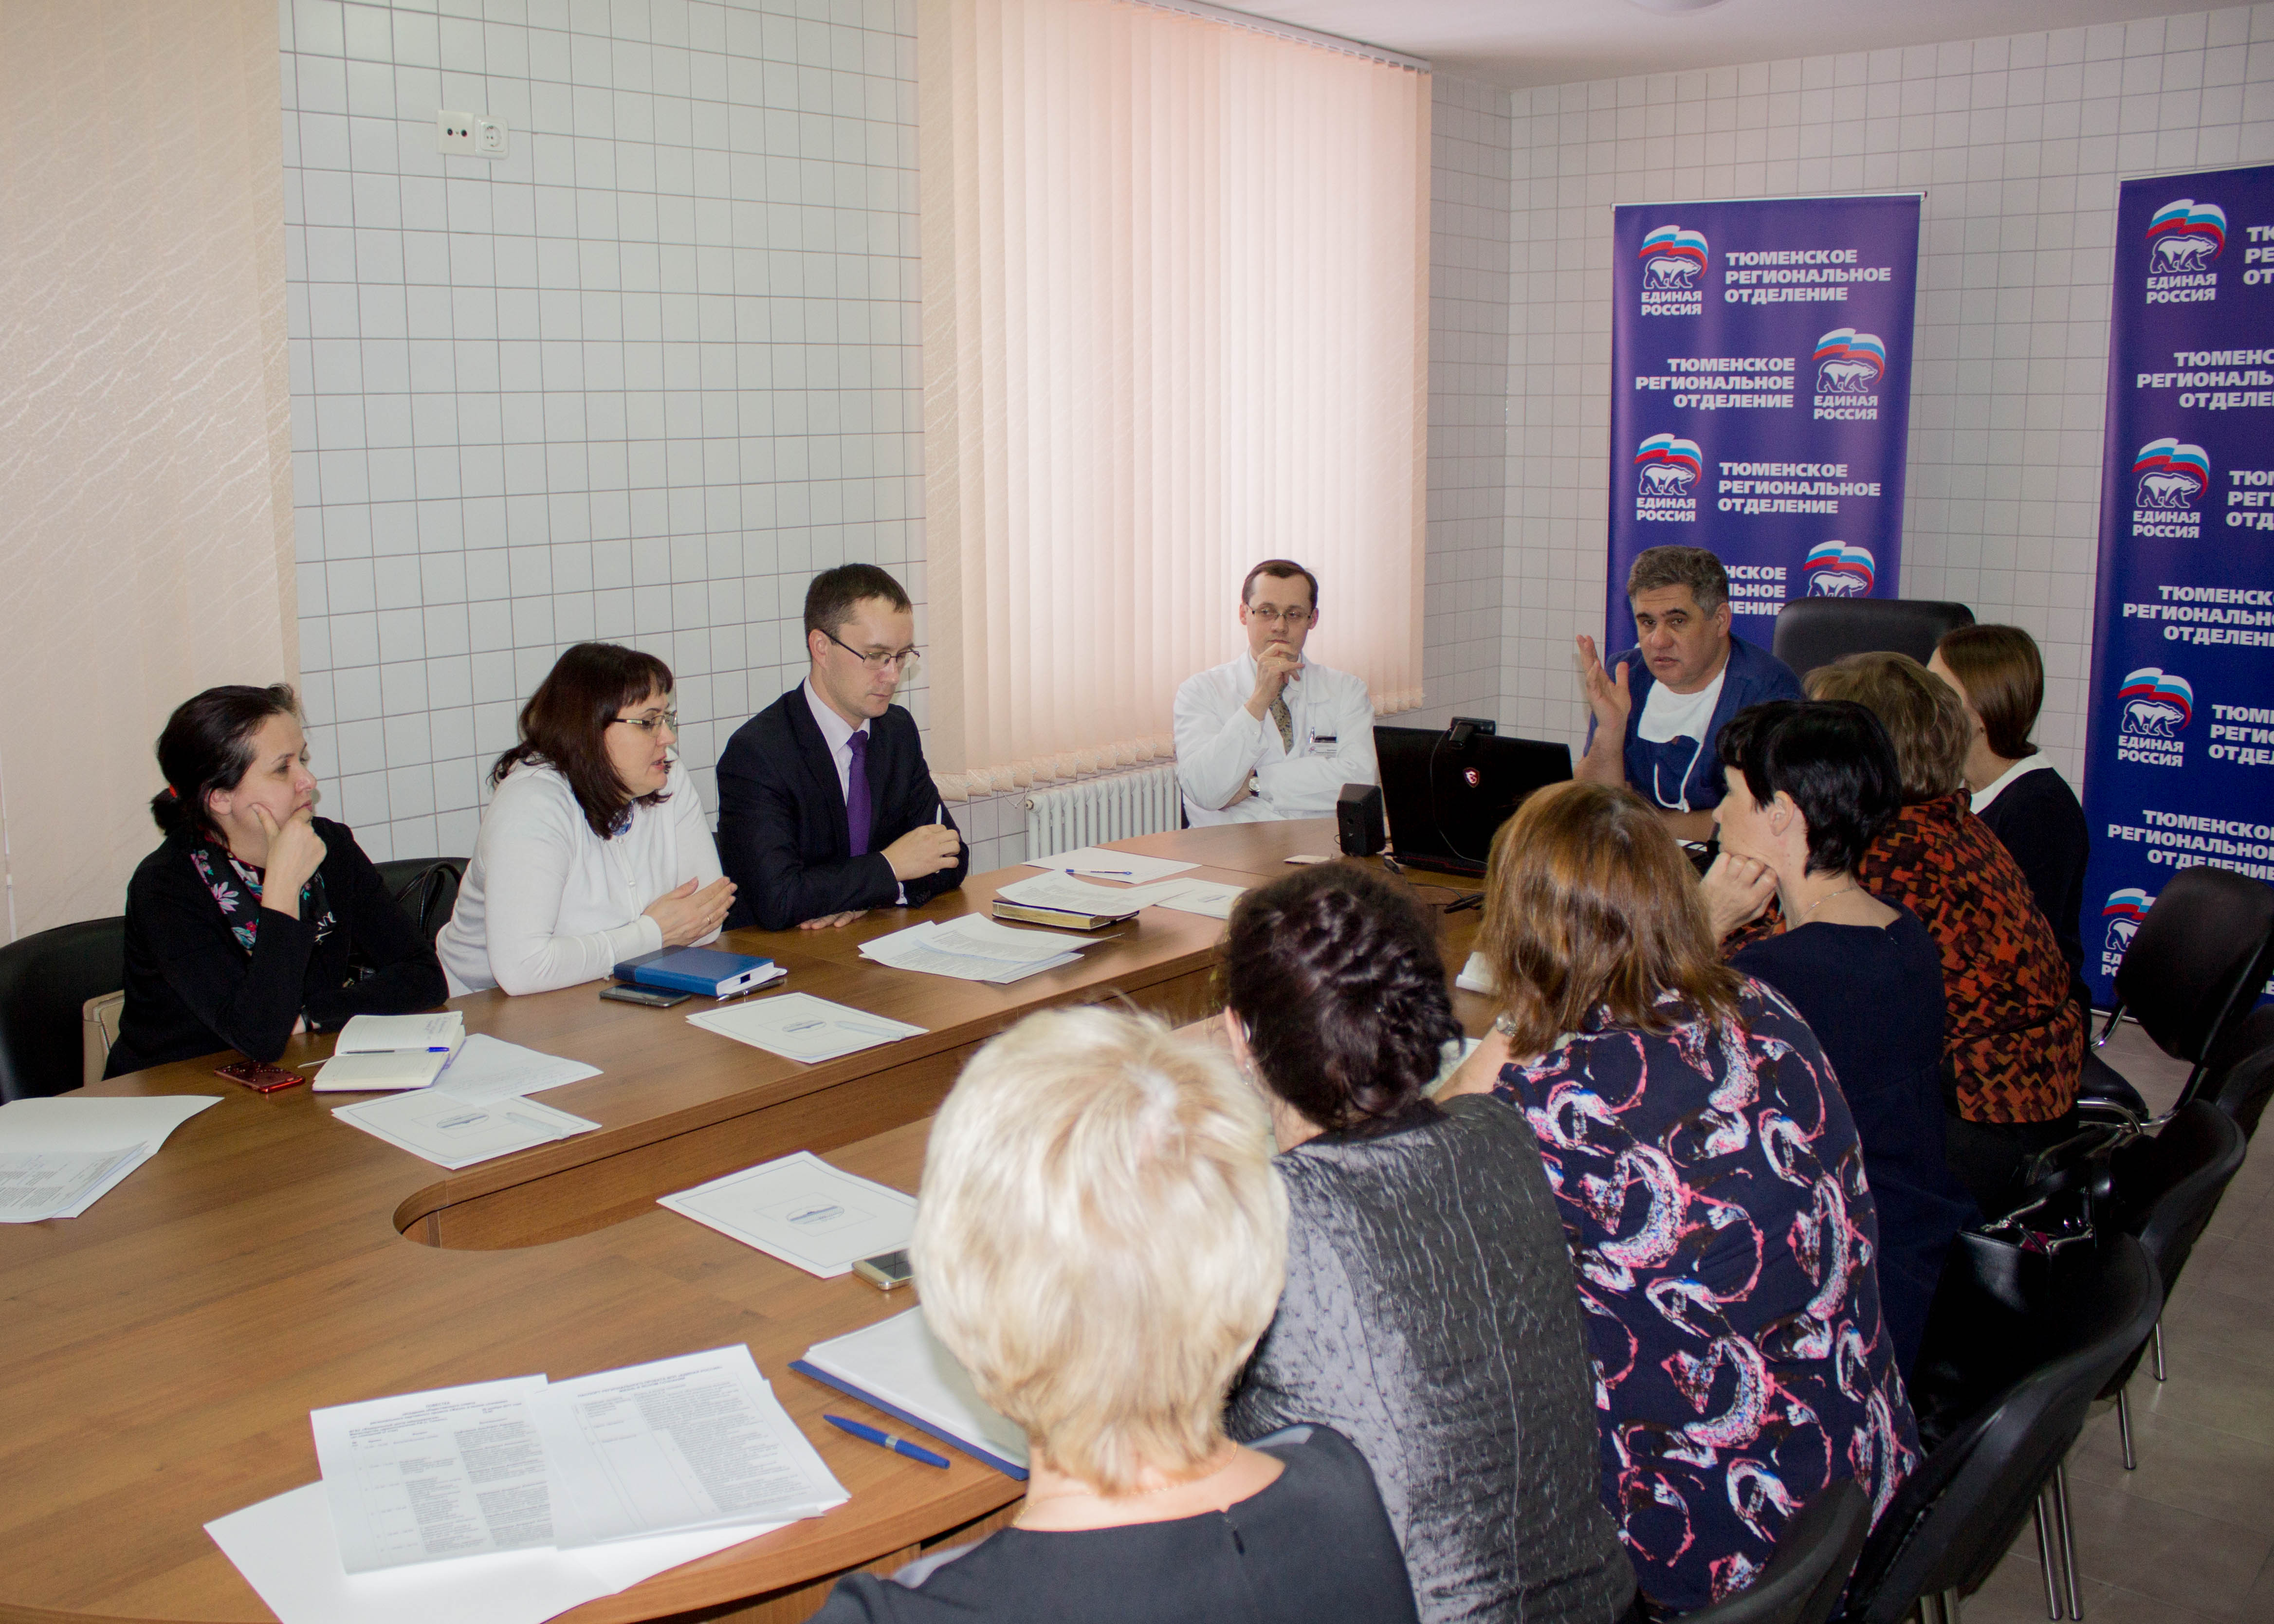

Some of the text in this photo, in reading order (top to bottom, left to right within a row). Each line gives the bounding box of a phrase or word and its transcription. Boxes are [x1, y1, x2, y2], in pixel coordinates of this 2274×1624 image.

[1725, 249, 1857, 266] ТЮМЕНСКОЕ
[1725, 267, 1891, 285] РЕГИОНАЛЬНОЕ
[2146, 273, 2217, 290] ЕДИНАЯ
[2243, 268, 2274, 285] ОТ
[1641, 291, 1702, 304] ЕДИНАЯ
[1724, 287, 1848, 305] ОТДЕЛЕНИЕ
[2146, 288, 2216, 304] РОССИЯ
[1641, 303, 1702, 316] РОССИЯ
[1667, 358, 1795, 372] ТЮМЕНСКОЕ
[2173, 349, 2274, 367] ТЮМЕНС
[1635, 376, 1794, 390] РЕГИОНАЛЬНОЕ
[2136, 370, 2274, 388] РЕГИОНАЛЬ
[1673, 394, 1794, 410] ОТДЕЛЕНИЕ
[1814, 395, 1878, 408] ЕДИНАЯ
[2179, 391, 2274, 410] ОТДЕЛЕ
[1814, 408, 1877, 420] РОССИЯ
[1719, 462, 1848, 477] ТЮМЕНСКОЕ
[1718, 480, 1881, 496] РЕГИОНАЛЬНОЕ
[1636, 497, 1696, 510] ЕДИНАЯ
[1718, 498, 1838, 514] ОТДЕЛЕНИЕ
[2227, 491, 2274, 507] РЕГ
[1636, 510, 1696, 522] РОССИЯ
[2133, 510, 2201, 524] ЕДИНАЯ
[2226, 511, 2274, 530] ОТД
[2132, 524, 2200, 538] РОССИЯ
[2158, 585, 2274, 606] ТЮМЕНСК
[2123, 603, 2274, 626] РЕГИОНАЛЬН
[2164, 625, 2274, 647] ОТДЕЛЕН
[2211, 704, 2274, 724] ТЮМ
[2118, 735, 2184, 754] ЕДИНАЯ
[2117, 748, 2184, 767] РОССИЯ
[2208, 744, 2274, 766] ОТДЕ
